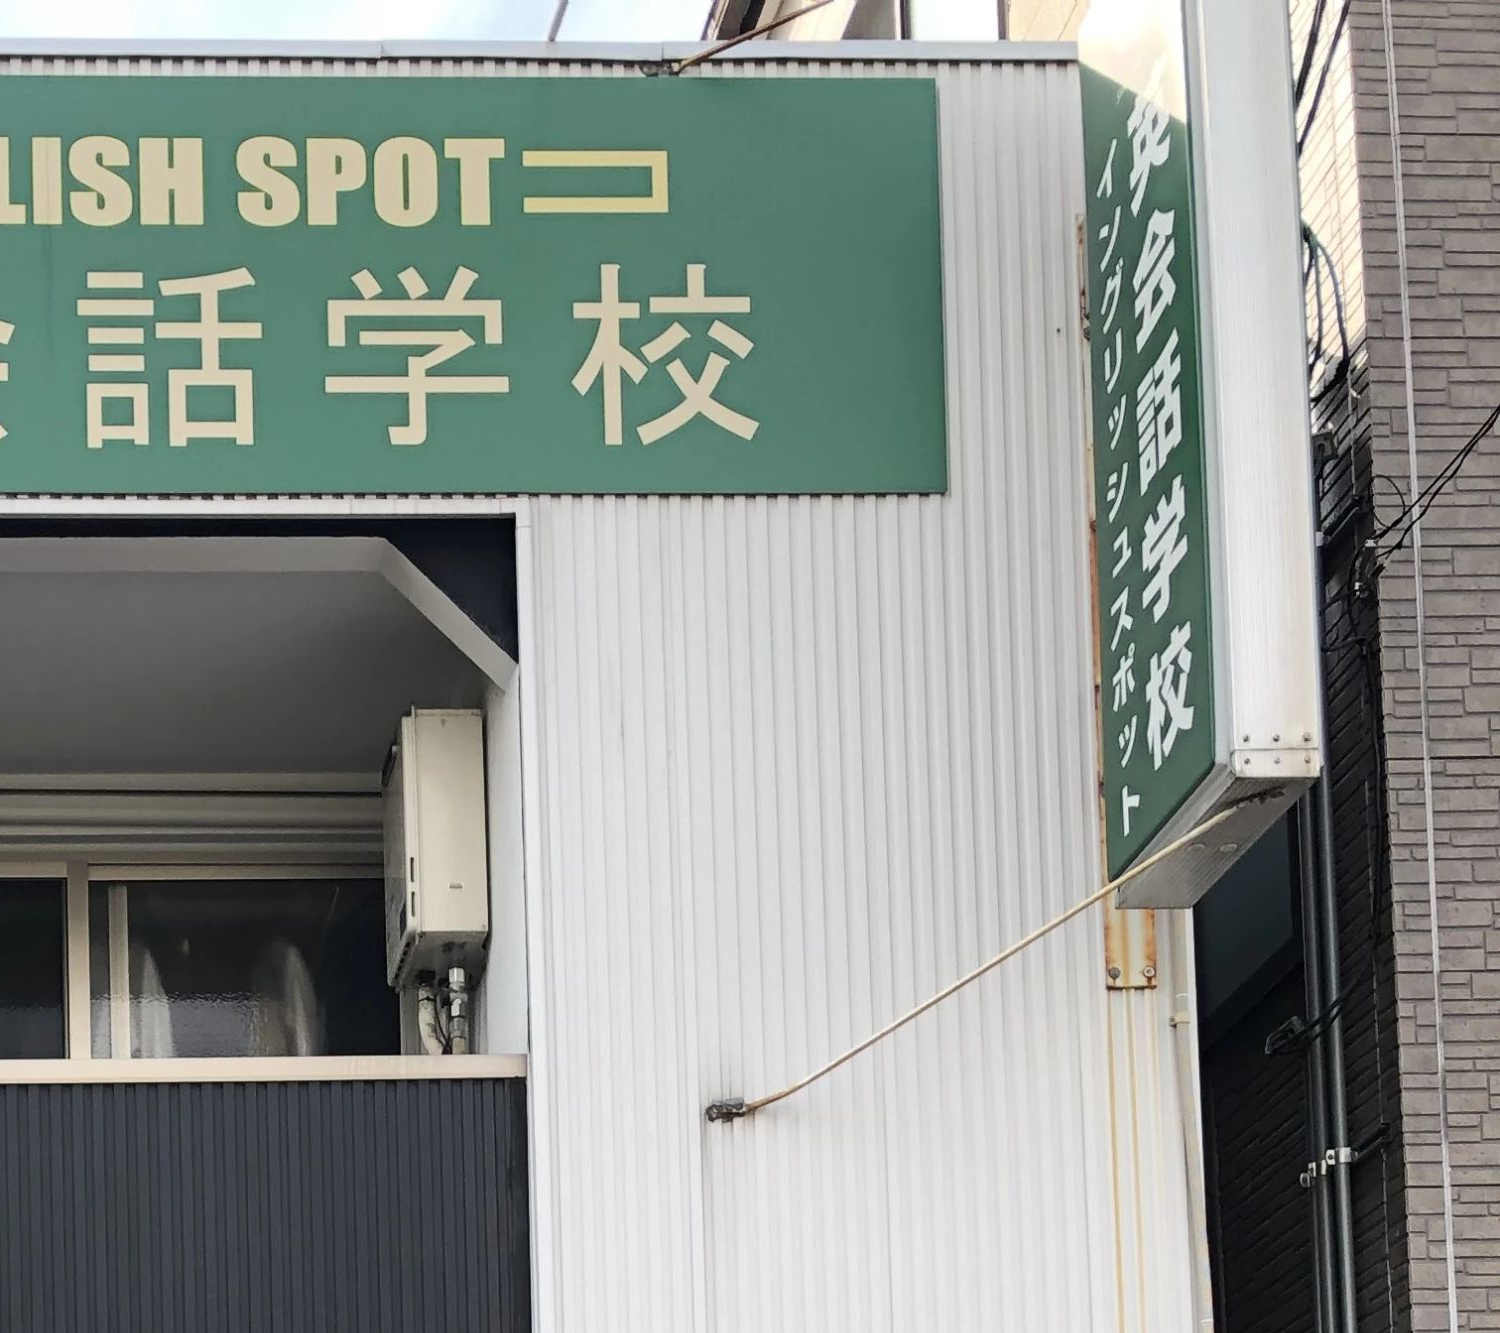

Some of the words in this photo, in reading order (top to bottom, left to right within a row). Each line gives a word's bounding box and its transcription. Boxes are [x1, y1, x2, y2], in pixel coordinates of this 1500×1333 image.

[236, 134, 505, 225] SPOT
[1096, 138, 1140, 836] イングリッシュスポット
[1127, 62, 1194, 771] 英会話学校
